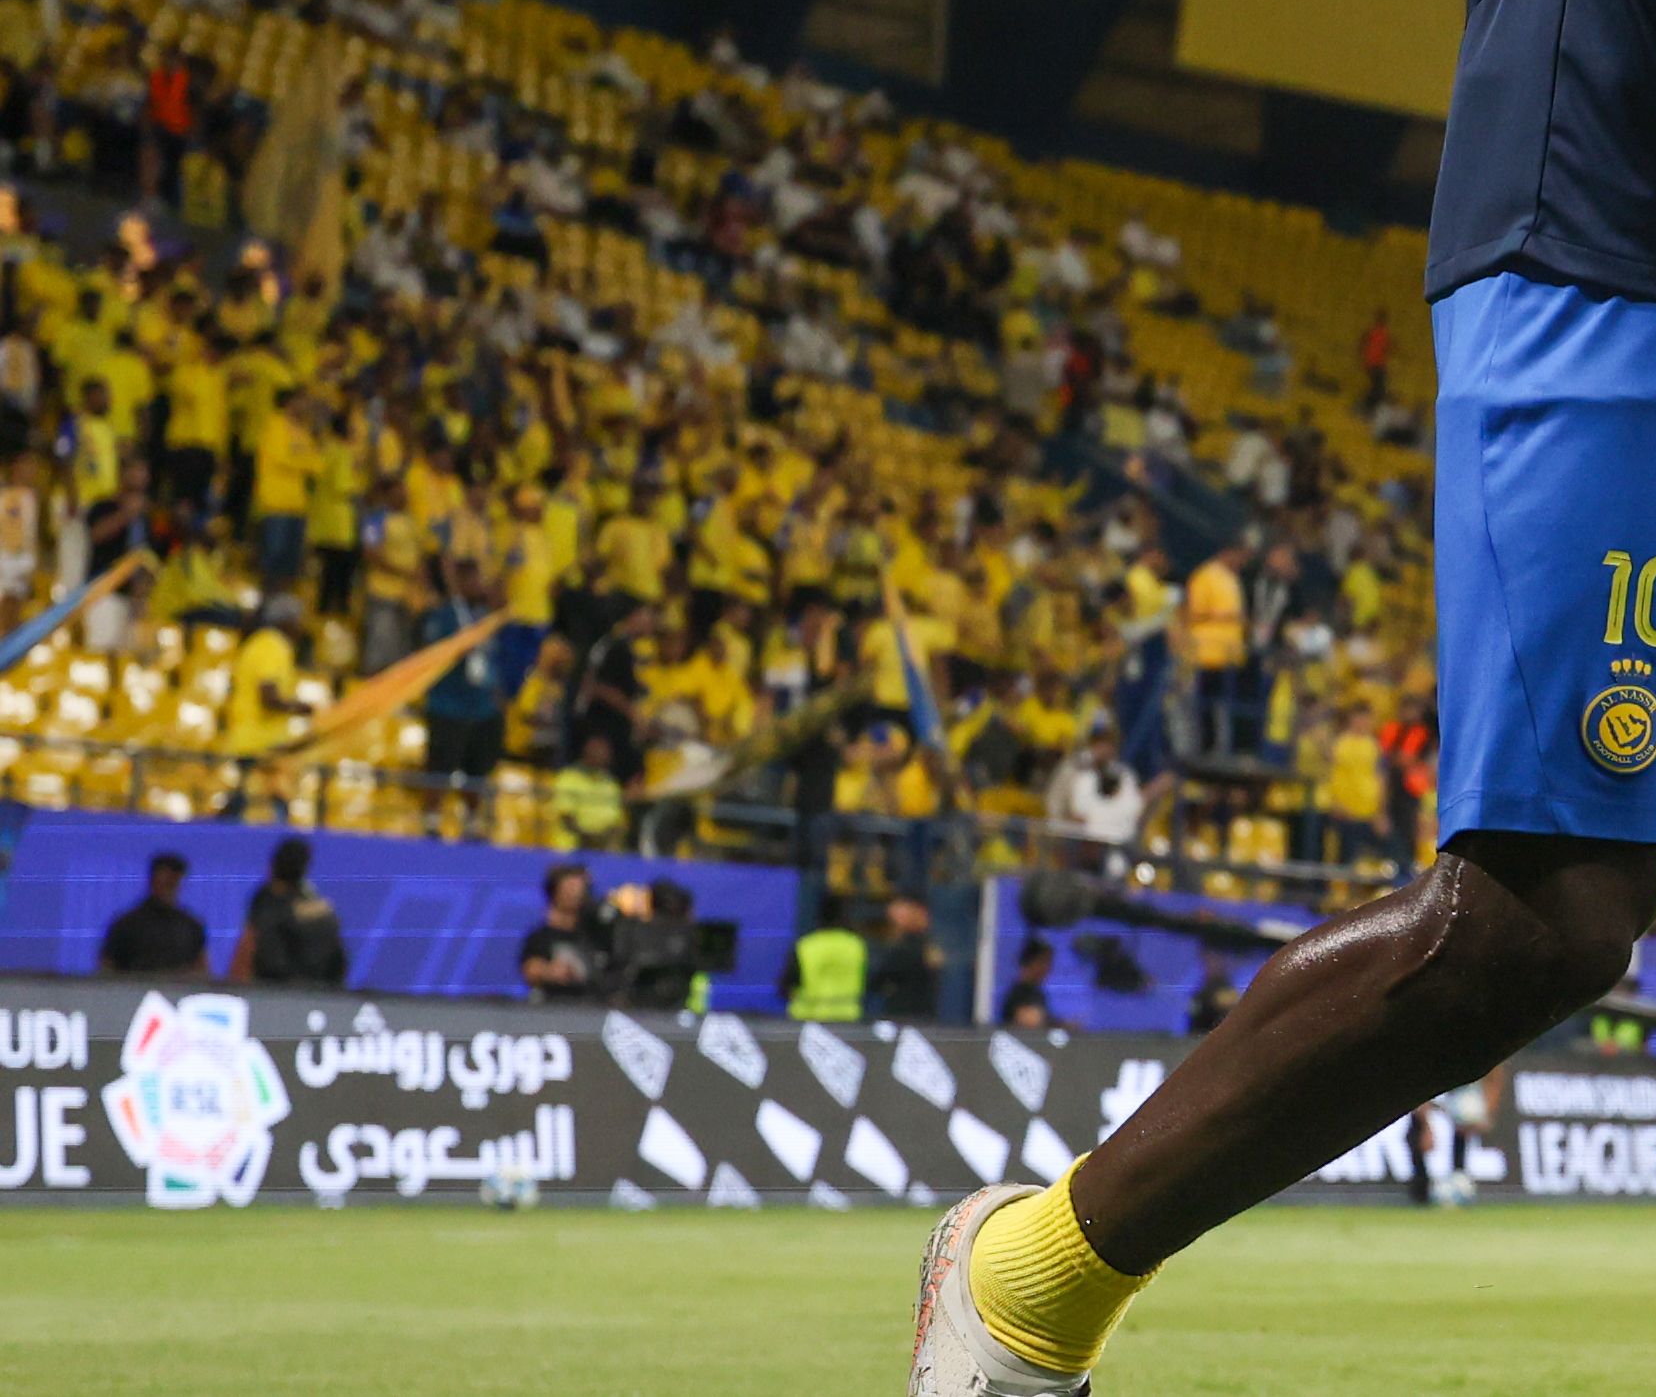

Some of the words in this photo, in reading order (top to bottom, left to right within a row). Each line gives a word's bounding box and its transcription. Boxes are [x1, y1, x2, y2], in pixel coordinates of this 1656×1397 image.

[1600, 695, 1618, 712] AL
[1619, 690, 1656, 714] NASSR
[1592, 739, 1633, 764] FOOTBALL
[1635, 743, 1656, 762] CLUB
[295, 1002, 446, 1091] روشن
[448, 1030, 573, 1111] دوري
[299, 1103, 577, 1210] السعودي
